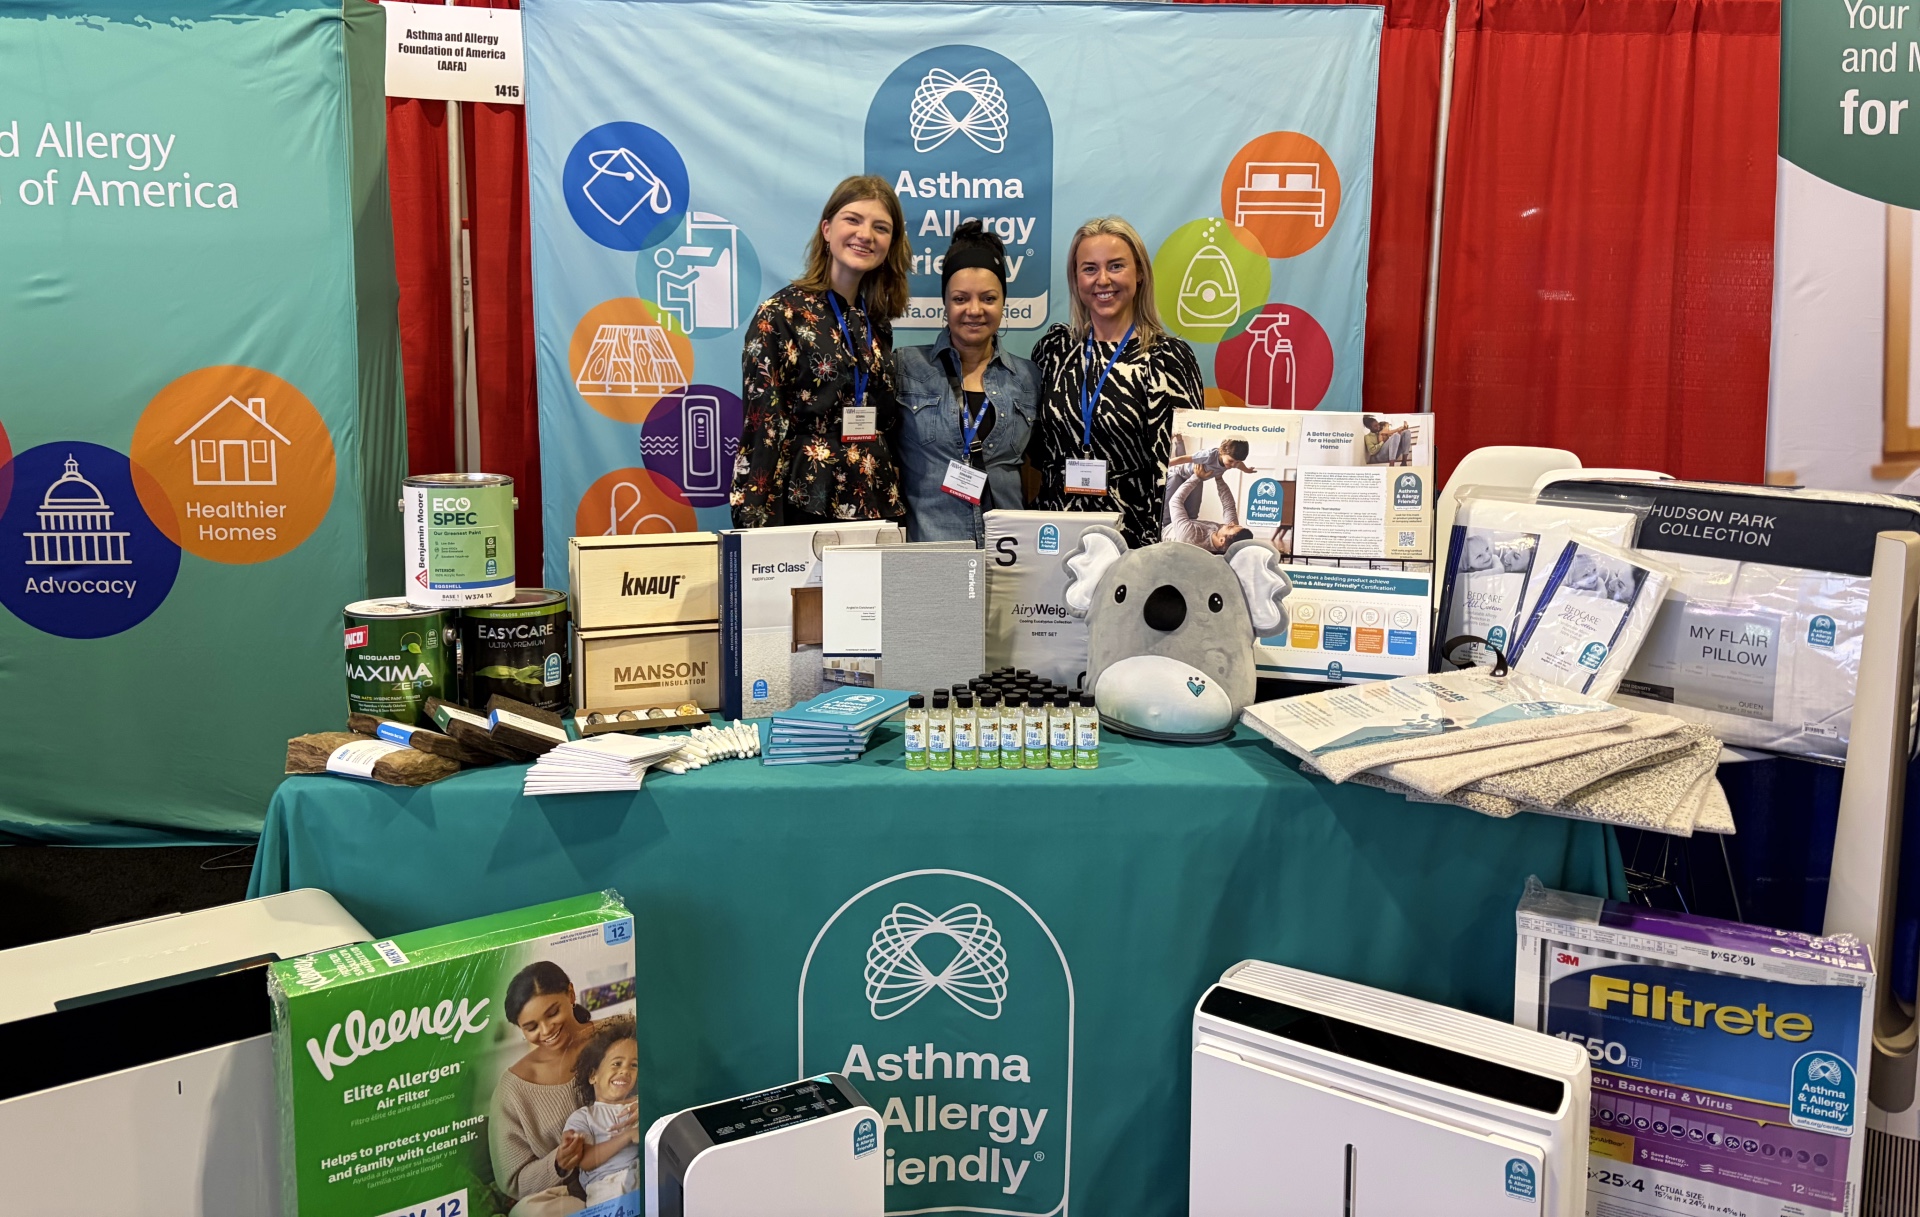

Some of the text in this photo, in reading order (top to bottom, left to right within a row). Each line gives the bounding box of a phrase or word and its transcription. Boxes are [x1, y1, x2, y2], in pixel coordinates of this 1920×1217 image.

[1844, 0, 1910, 29] Your
[406, 29, 499, 46] Asthma and Allergy
[398, 43, 506, 60] Foundation of America
[1842, 41, 1897, 73] and
[437, 60, 467, 72] (AAFA)
[494, 85, 520, 97] 1415
[1840, 89, 1909, 135] for
[35, 121, 176, 171] Allergy
[19, 169, 239, 209] of America
[894, 170, 1024, 199] Asthma
[918, 209, 1037, 245] Allrgy
[1187, 421, 1286, 434] Certified Products Guide
[186, 501, 287, 518] Healthier
[433, 497, 471, 512] ECO
[1257, 505, 1280, 513] Allergy
[433, 512, 478, 526] SPEC
[1251, 511, 1277, 519] Friendly
[1651, 504, 1777, 529] HUDSON PARK
[199, 524, 277, 541] Homes
[1659, 522, 1772, 547] COLLECTION
[418, 525, 427, 568] Benjamin
[995, 536, 1019, 566] S
[752, 563, 775, 574] First
[25, 576, 137, 598] Advocacy
[968, 568, 976, 599] Tarkett
[1361, 584, 1397, 592] Certification?
[1466, 591, 1504, 604] BEDCARE
[1564, 604, 1601, 625] BEDCARE
[488, 639, 546, 649] ULTRA PREMIUM
[1689, 625, 1768, 648] MY FLAIR
[1702, 645, 1768, 667] PILLOW
[345, 662, 433, 682] MAXIMA
[614, 661, 706, 683] MANSON
[391, 679, 433, 691] ZERO
[661, 678, 706, 687] INSULATION
[1738, 701, 1764, 711] QUEEN
[955, 732, 966, 740] Free
[611, 926, 625, 938] 12
[1556, 953, 1579, 967] 3M
[1589, 974, 1813, 1042] Filtrete
[306, 997, 491, 1081] Kleenex
[840, 1042, 1031, 1084] Asthma
[343, 1061, 461, 1104] Elite Allergen
[1801, 1083, 1846, 1099] Asthma
[376, 1089, 430, 1111] Air Filter
[1618, 1080, 1677, 1100] Bacteria
[1681, 1092, 1690, 1102] &
[1695, 1095, 1733, 1110] Virus
[1797, 1093, 1850, 1112] & Allergy
[350, 1116, 370, 1127] Filtro
[387, 1108, 396, 1117] de
[397, 1105, 411, 1114] aire
[412, 1102, 421, 1111] de
[421, 1092, 455, 1109] alérgenos
[883, 1094, 1048, 1143] Allergy
[1800, 1103, 1845, 1121] Friendly
[321, 1114, 485, 1170] Helps to protect your home
[857, 1133, 874, 1141] Asthma
[328, 1131, 479, 1184] and family with clean air.
[1665, 1154, 1686, 1163] Energy.
[352, 1173, 376, 1185] Ayuda
[381, 1162, 413, 1177] proteger
[413, 1160, 422, 1168] su
[422, 1154, 442, 1166] hogar
[443, 1151, 448, 1159] y
[367, 1177, 391, 1189] familia
[405, 1169, 420, 1178] aire
[420, 1163, 444, 1175] limpio.
[1509, 1173, 1532, 1183] Asthma
[1513, 1180, 1533, 1190] Allergy
[1509, 1184, 1532, 1196] Friendly
[1655, 1184, 1704, 1201] ACTUAL SIZE:
[1791, 1183, 1805, 1195] 12
[436, 1198, 462, 1217] 12
